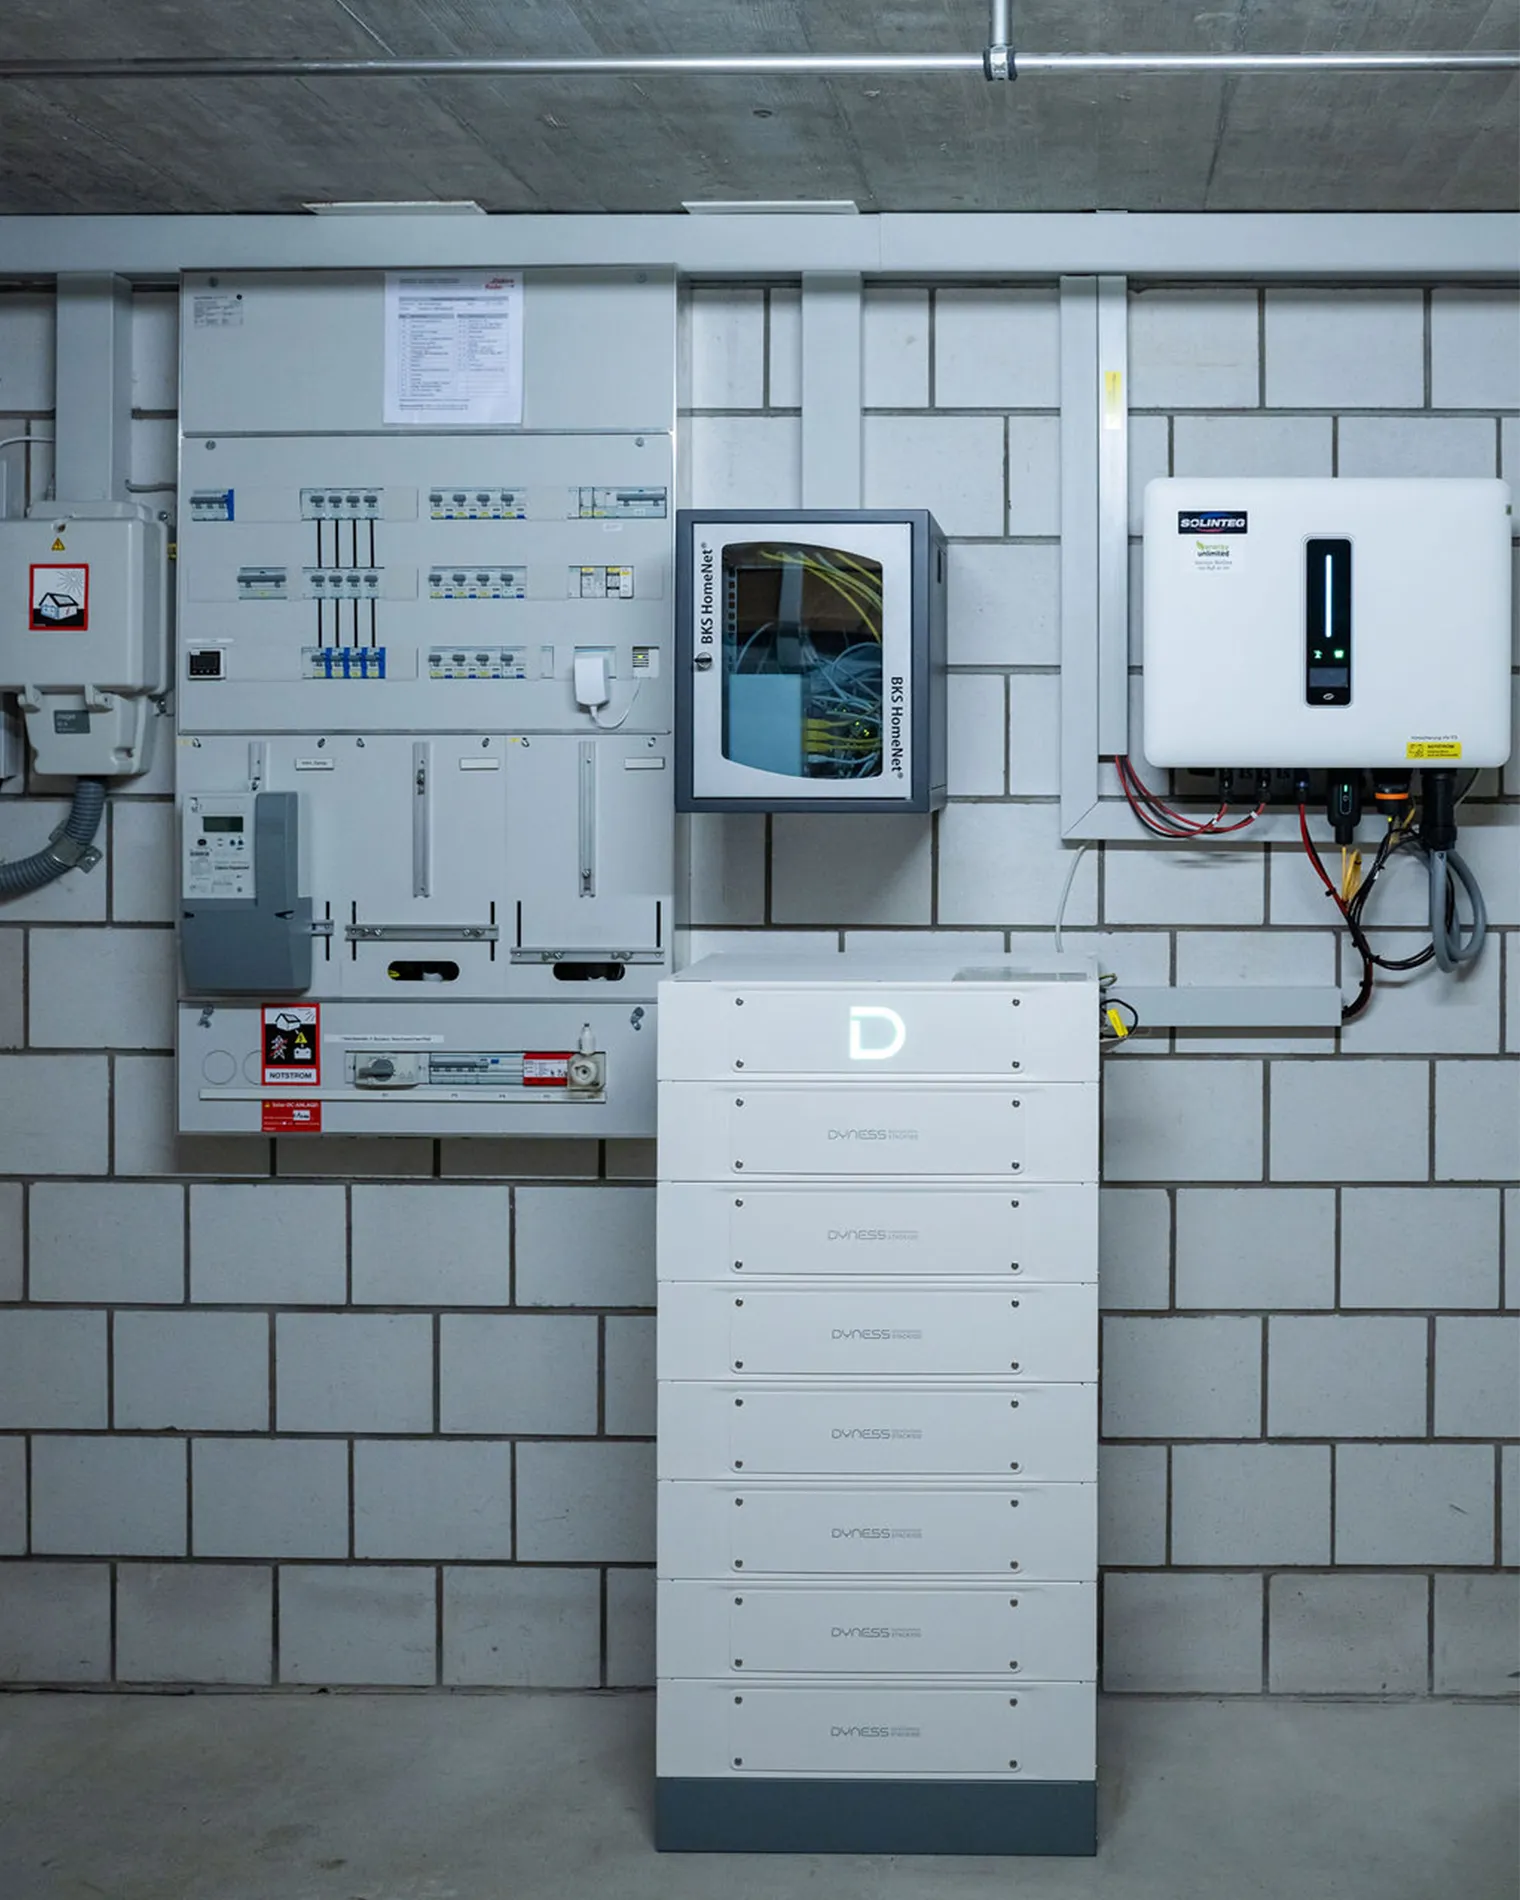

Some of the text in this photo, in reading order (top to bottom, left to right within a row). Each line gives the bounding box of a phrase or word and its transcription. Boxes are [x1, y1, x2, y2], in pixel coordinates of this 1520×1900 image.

[1181, 518, 1245, 527] SOLINTEG
[701, 618, 713, 645] BKS
[891, 676, 904, 703] BKS
[849, 1006, 906, 1060] D
[269, 1071, 312, 1080] NOTSTROM
[828, 1129, 887, 1140] DYNESS
[828, 1229, 887, 1240] DYNESS
[831, 1329, 891, 1340] DYNESS
[831, 1428, 891, 1439] DYNESS
[831, 1528, 891, 1539] DYNESS
[830, 1627, 890, 1638] DYNESS
[830, 1726, 889, 1737] DYNESS
